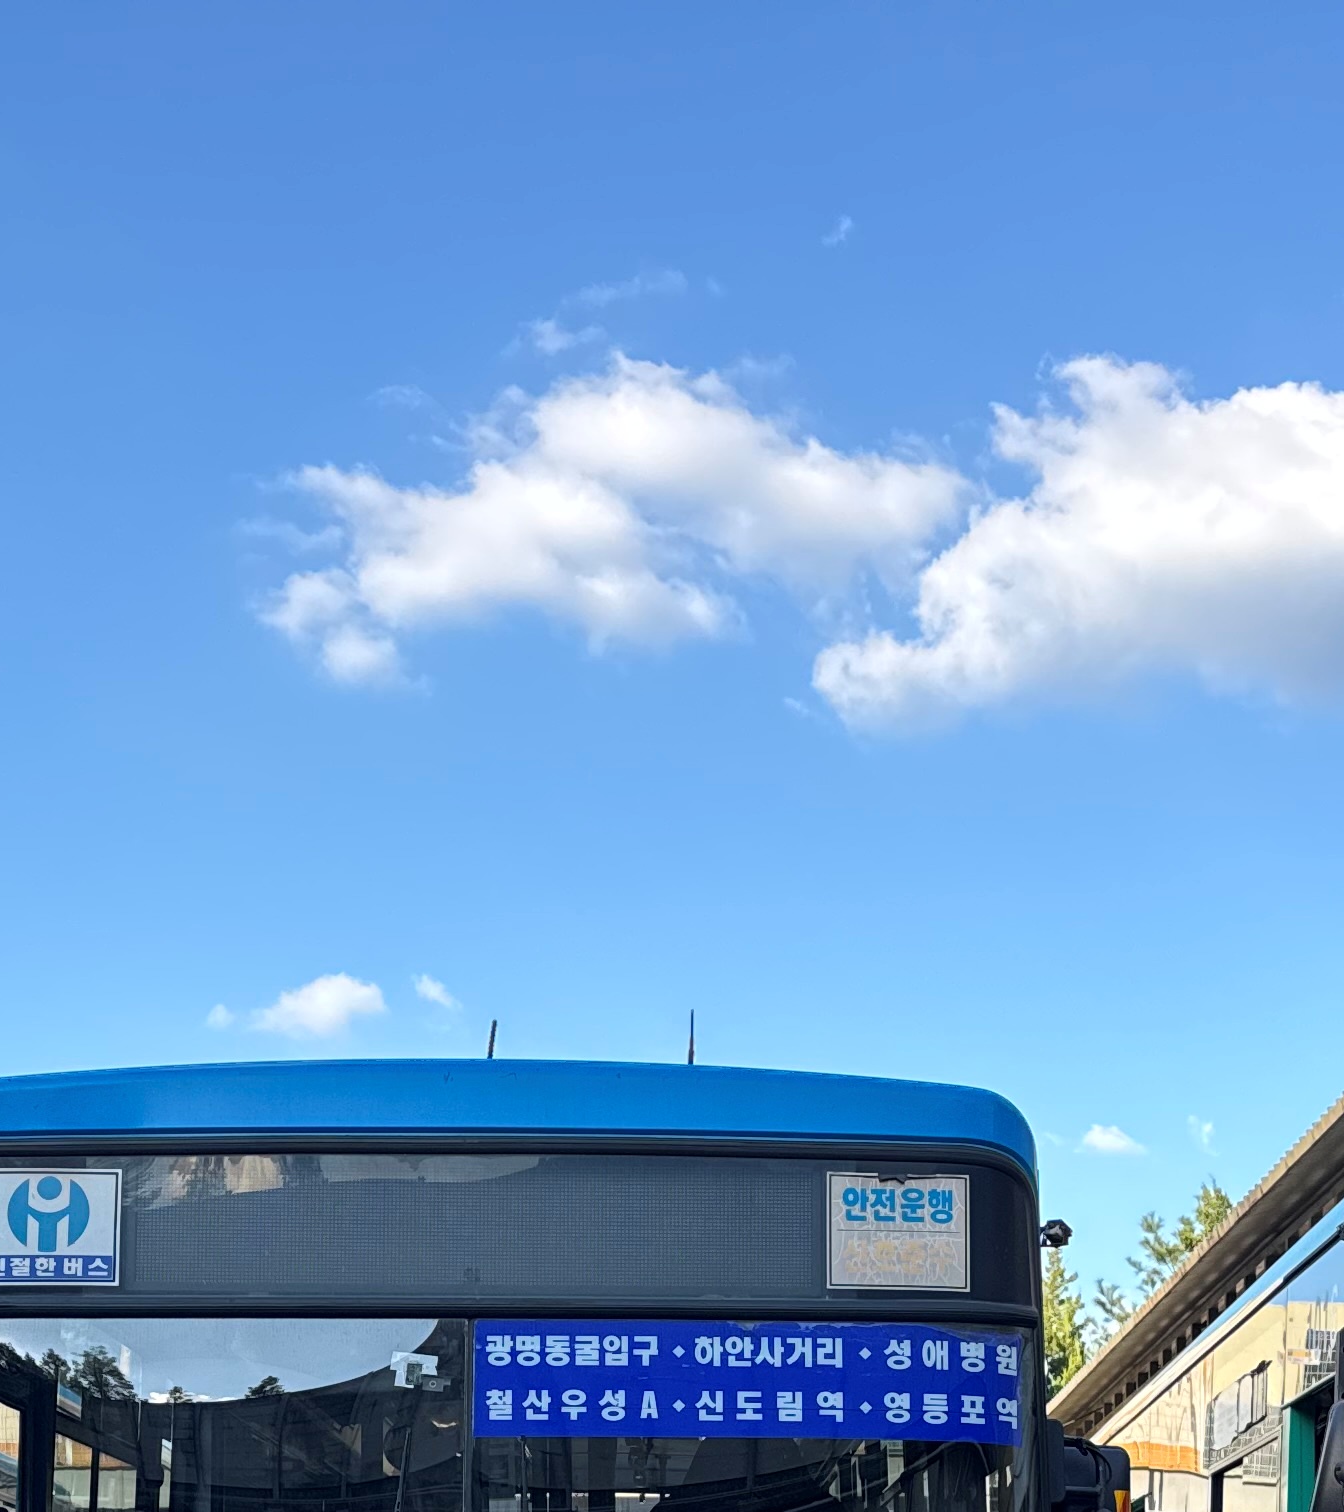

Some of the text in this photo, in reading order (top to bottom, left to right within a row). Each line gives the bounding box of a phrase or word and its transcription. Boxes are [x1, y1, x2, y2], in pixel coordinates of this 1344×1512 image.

[842, 1187, 953, 1224] 안전운행
[62, 1257, 109, 1277] 버스
[485, 1334, 1018, 1377] 광명동굴입구 하안사거리 성애병원
[694, 1390, 844, 1423] 신도림역
[883, 1391, 1018, 1430] 영등포역
